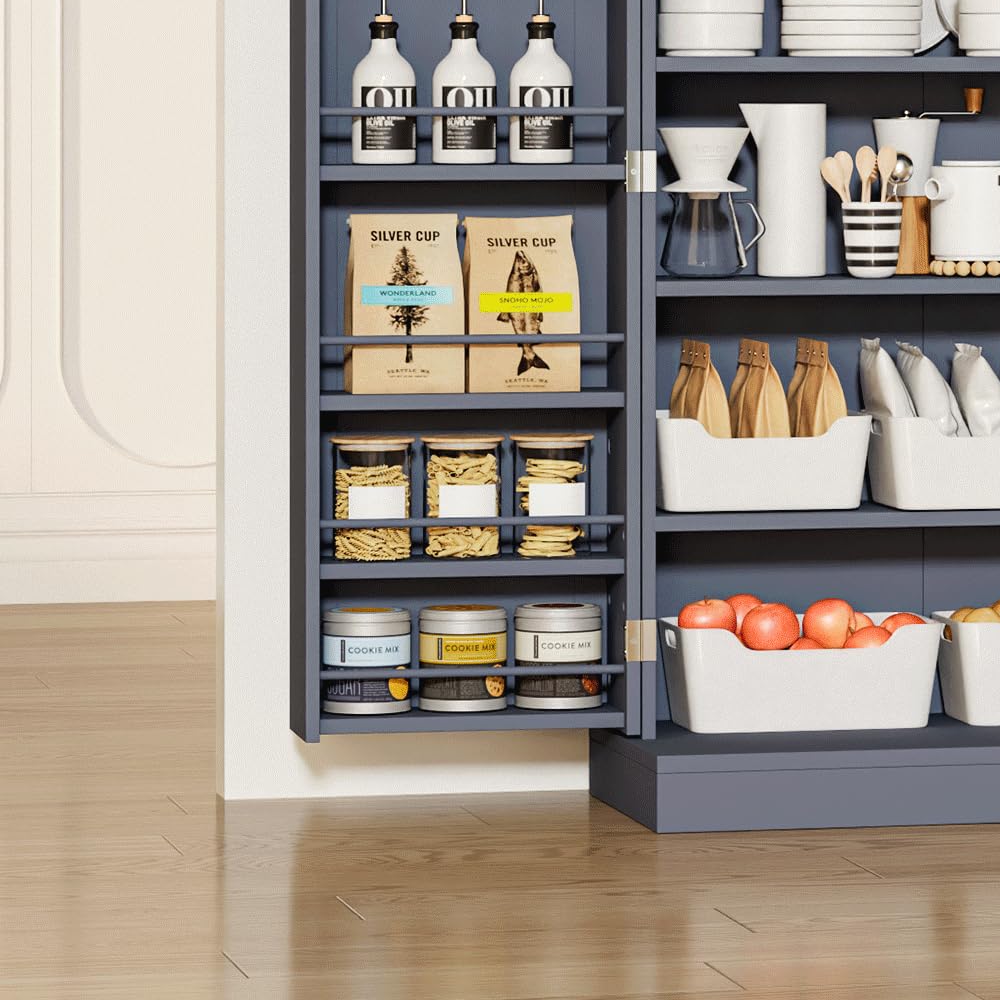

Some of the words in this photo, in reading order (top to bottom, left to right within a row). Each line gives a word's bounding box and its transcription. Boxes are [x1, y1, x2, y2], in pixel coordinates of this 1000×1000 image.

[370, 230, 412, 241] SILVER
[416, 230, 440, 241] CUP
[486, 237, 528, 247] SILVER
[532, 237, 556, 247] CUP
[348, 646, 383, 654] COOKIE
[445, 644, 479, 652] COOKIE
[481, 643, 496, 651] MIX
[541, 642, 575, 650] COOKIE
[578, 641, 591, 649] MIX
